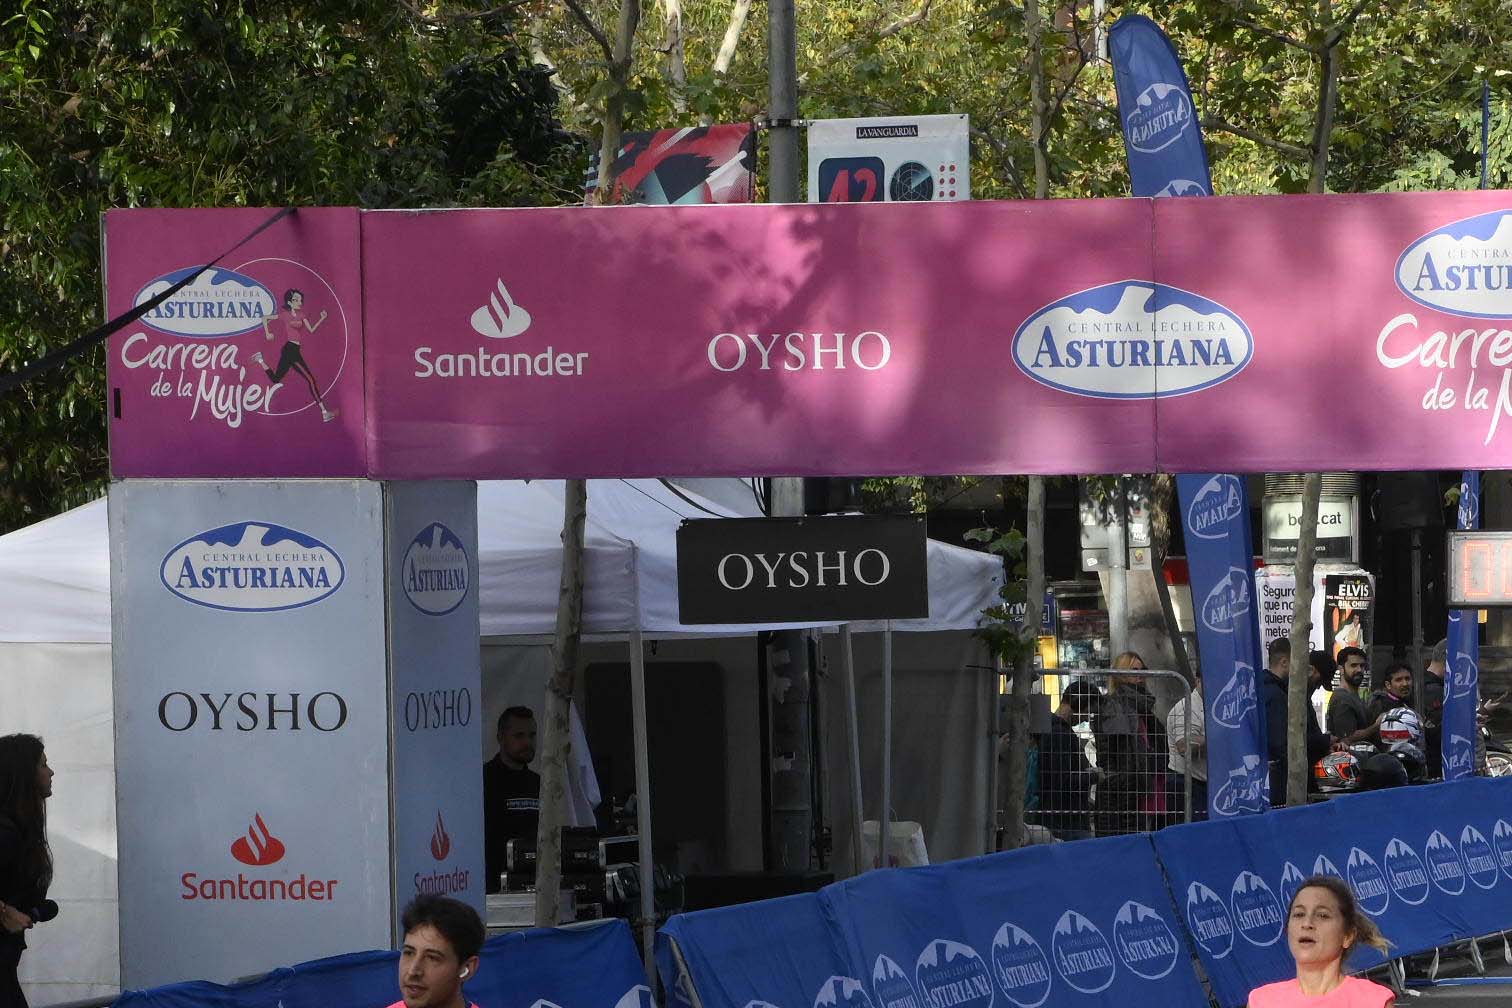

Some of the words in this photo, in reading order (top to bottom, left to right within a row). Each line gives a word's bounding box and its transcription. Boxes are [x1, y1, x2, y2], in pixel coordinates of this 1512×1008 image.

[167, 290, 210, 298] ENTRAL
[1068, 322, 1143, 333] CENTRAL
[1151, 321, 1226, 332] LECHERA
[121, 333, 240, 369] Carrera
[414, 346, 589, 377] Santander
[707, 332, 891, 371] OYSHO
[1031, 326, 1235, 368] ASTURIANA
[151, 373, 172, 397] de
[178, 373, 192, 396] la
[190, 366, 283, 428] Mujer
[1422, 371, 1456, 410] de
[1465, 370, 1488, 410] la
[175, 555, 332, 589] ASTURIANA
[203, 553, 261, 562] CENTRAL
[266, 553, 325, 562] LECHERA
[717, 549, 890, 590] OYSHO
[407, 558, 466, 593] ASTURIANA
[1339, 584, 1369, 596] ELVIS
[1264, 601, 1280, 611] que
[158, 691, 348, 732] OYSHO
[405, 687, 471, 732] OYSHO
[181, 873, 341, 900] Santander
[414, 868, 470, 897] Santander
[997, 958, 1049, 990] ASTURIANA
[1058, 945, 1112, 976] ASTURIANA
